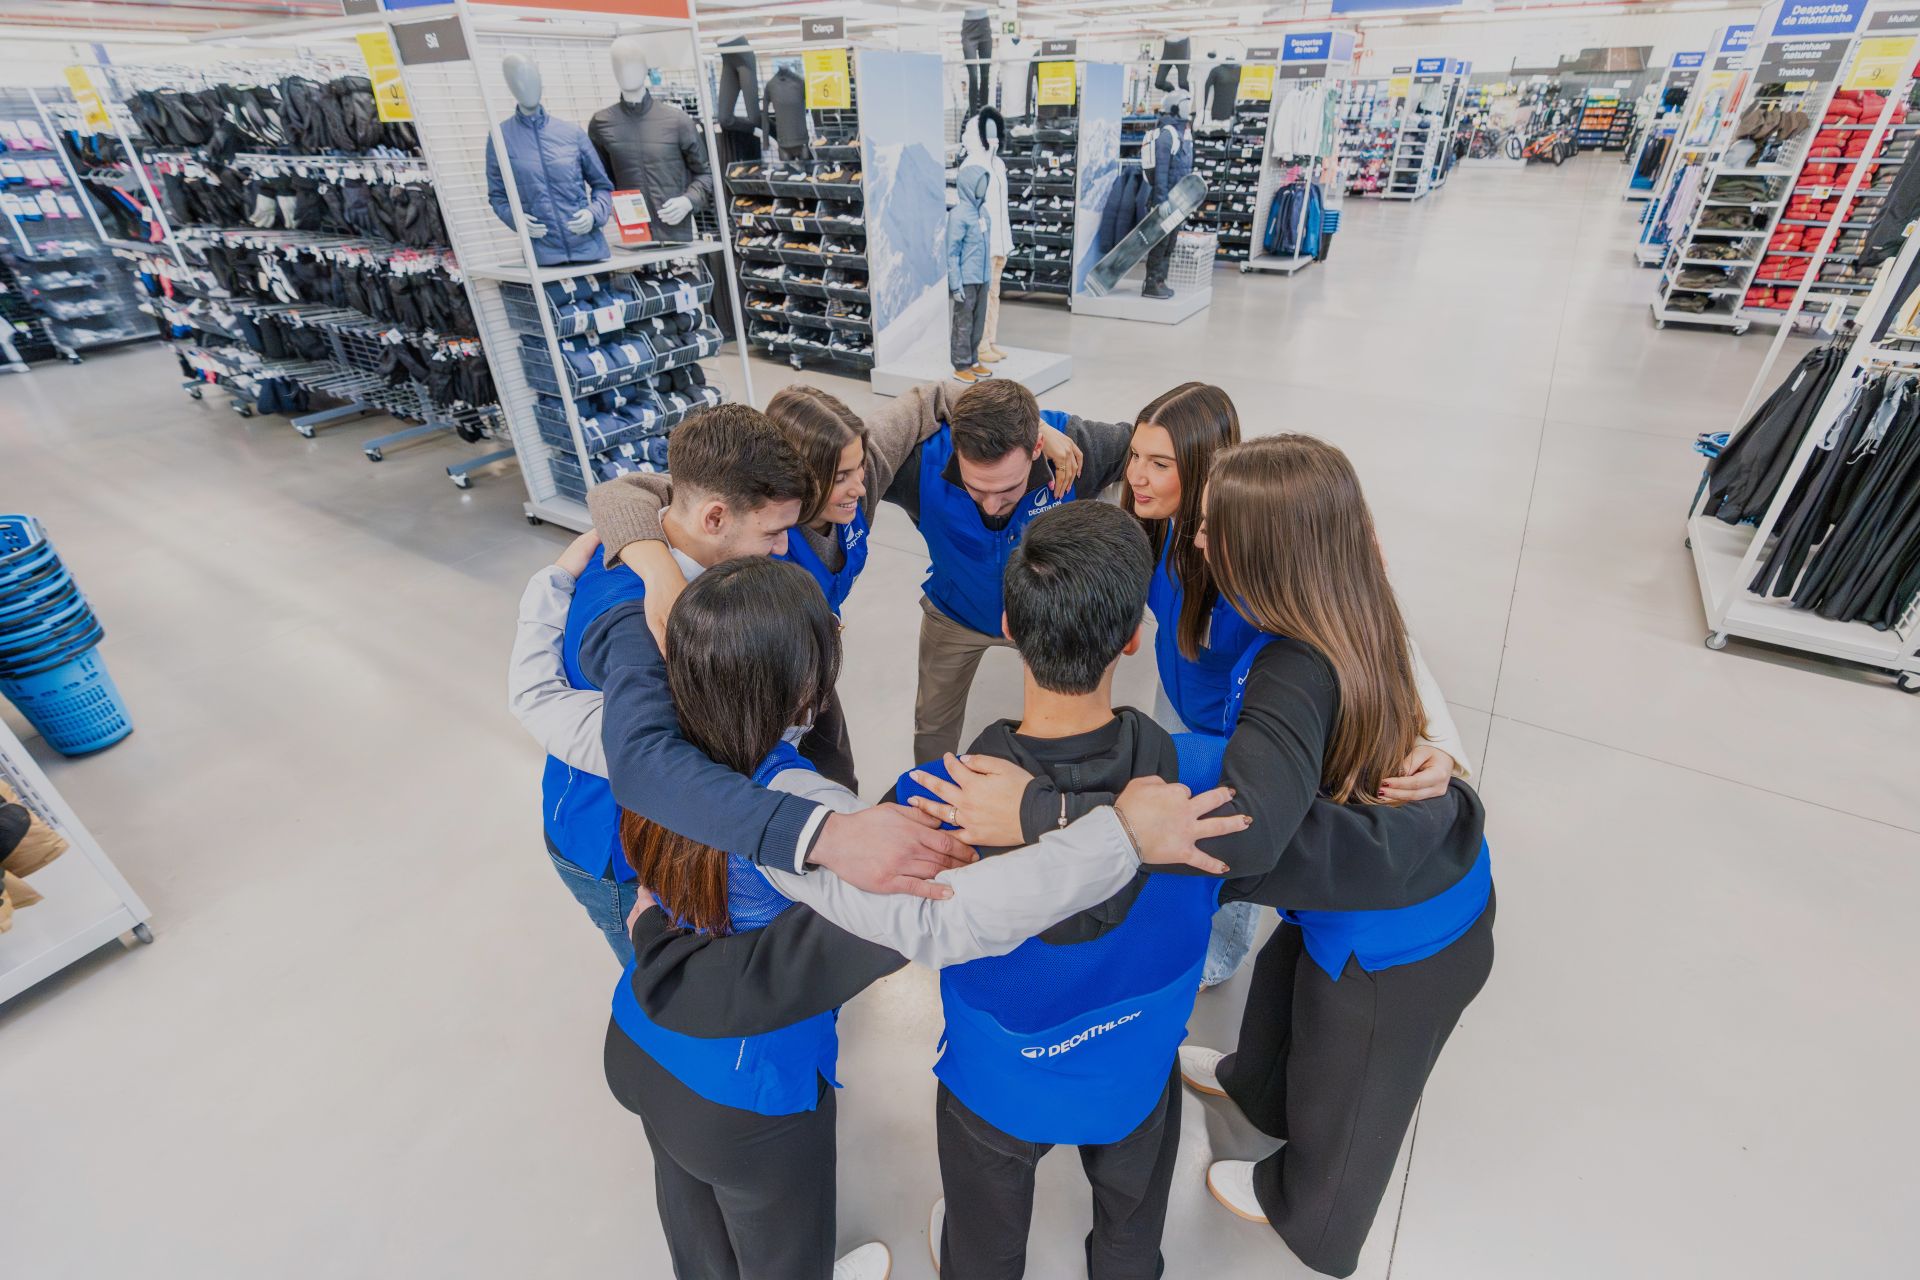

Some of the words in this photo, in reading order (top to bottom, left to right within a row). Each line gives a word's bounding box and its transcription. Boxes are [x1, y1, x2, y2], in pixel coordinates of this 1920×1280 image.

[1792, 4, 1849, 15] Desportos
[1782, 16, 1797, 25] de
[1797, 14, 1853, 25] montanha
[1887, 14, 1918, 24] Mulher
[812, 24, 834, 34] Criança
[1781, 42, 1831, 52] Caminhada
[1783, 51, 1822, 59] natureza
[1778, 67, 1815, 77] Trekking
[1048, 1010, 1142, 1058] DECATHLON
